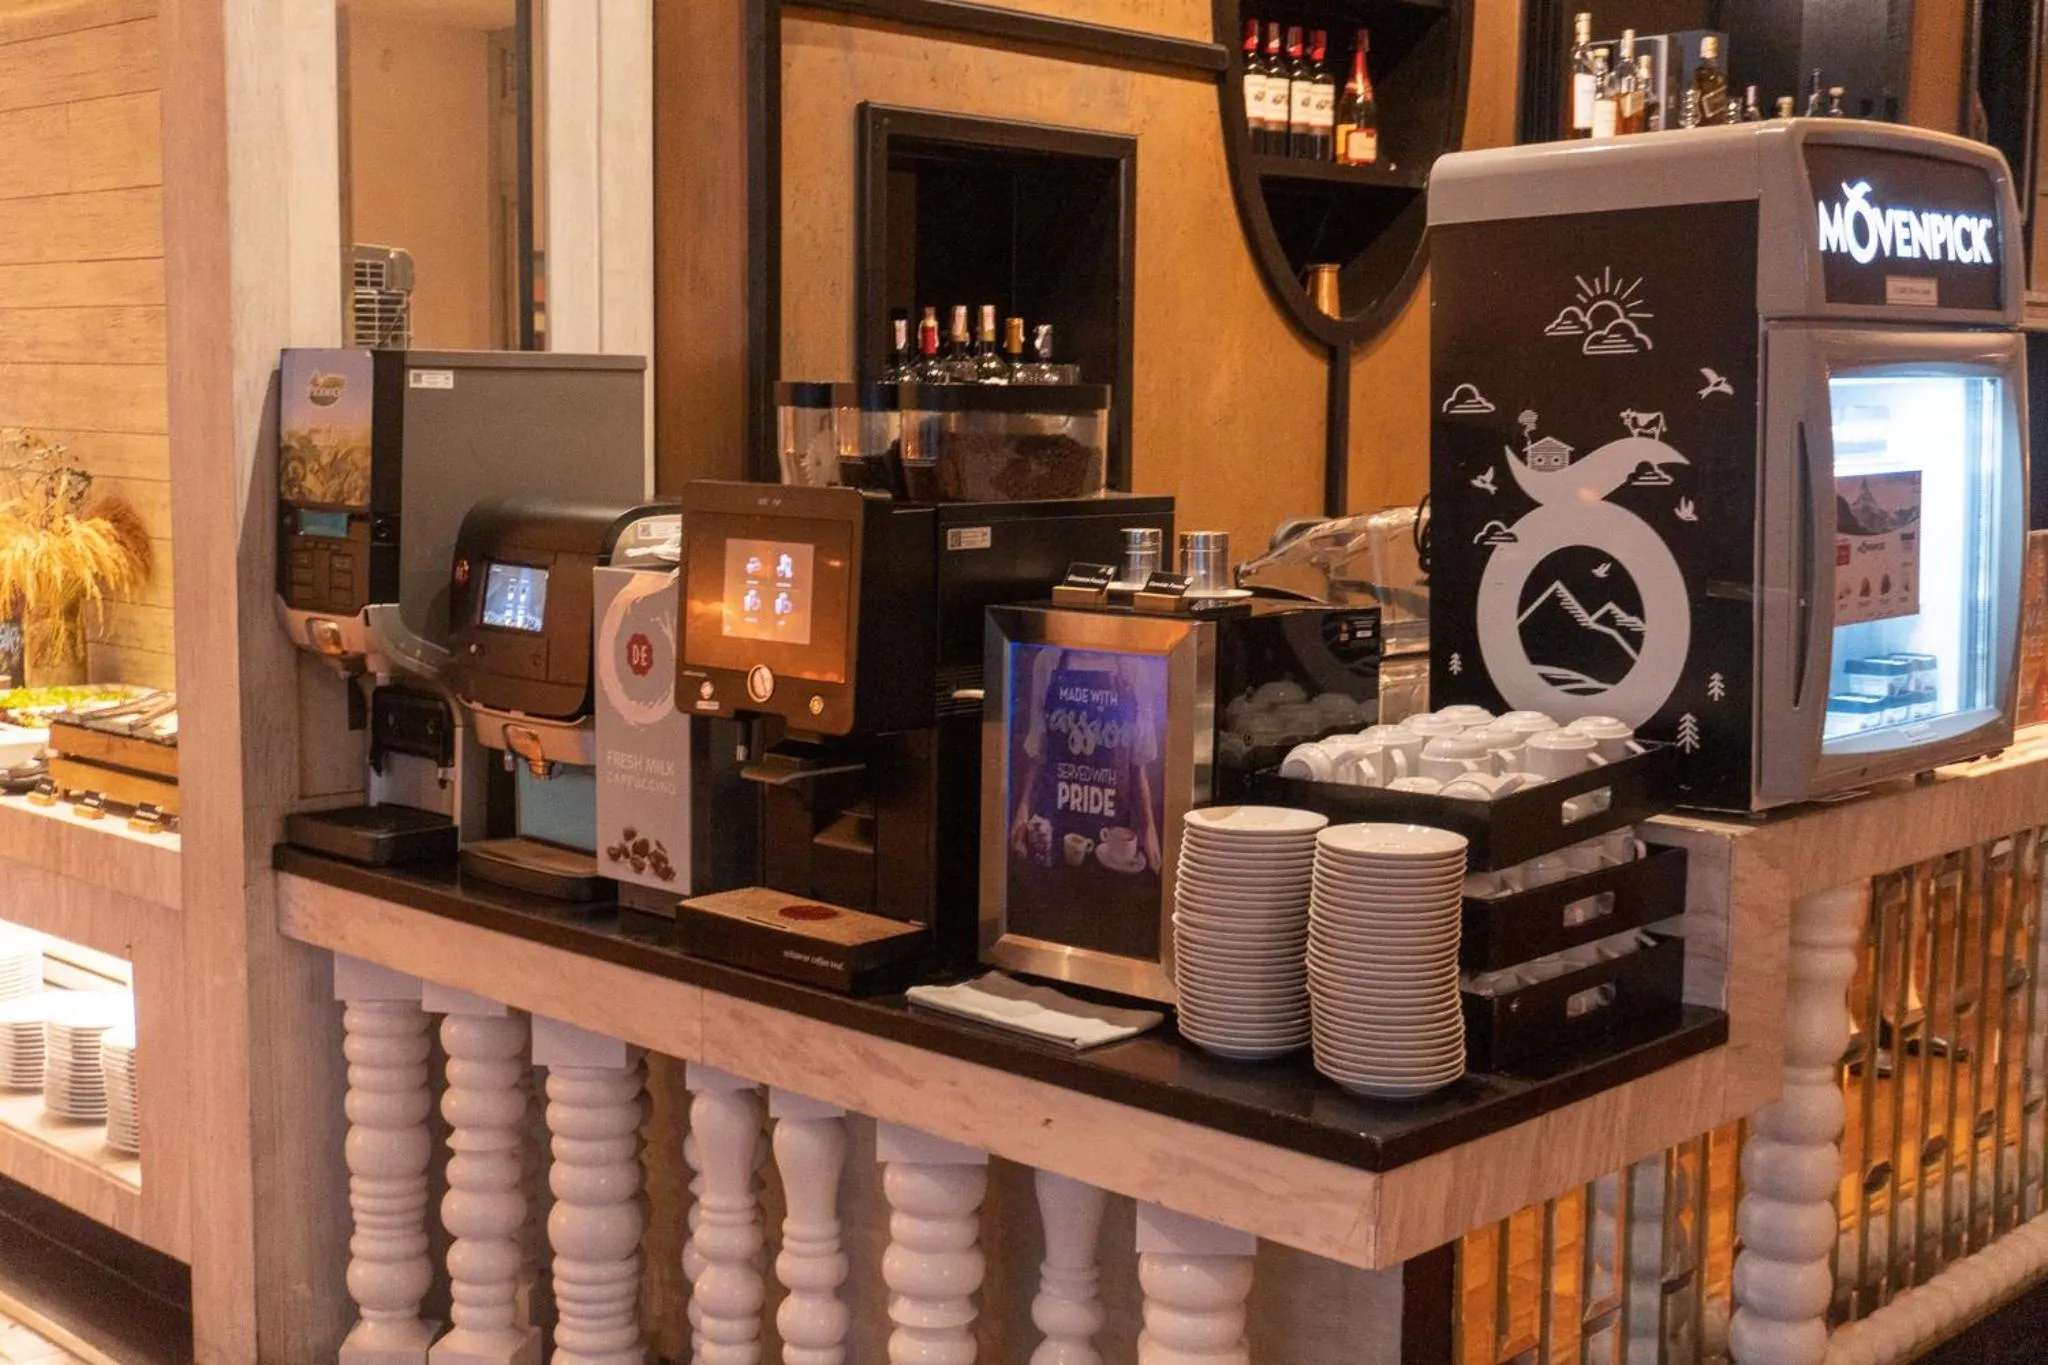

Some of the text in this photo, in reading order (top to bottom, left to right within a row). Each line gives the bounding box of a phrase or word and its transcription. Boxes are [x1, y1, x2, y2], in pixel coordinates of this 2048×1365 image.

[631, 644, 648, 667] DE
[1059, 686, 1118, 706] MADE WITH
[606, 749, 675, 777] FRESH MILK
[1056, 762, 1117, 787] SERVED WITH
[606, 770, 677, 796] CAPPUCCINO
[1056, 781, 1117, 818] PRIDE
